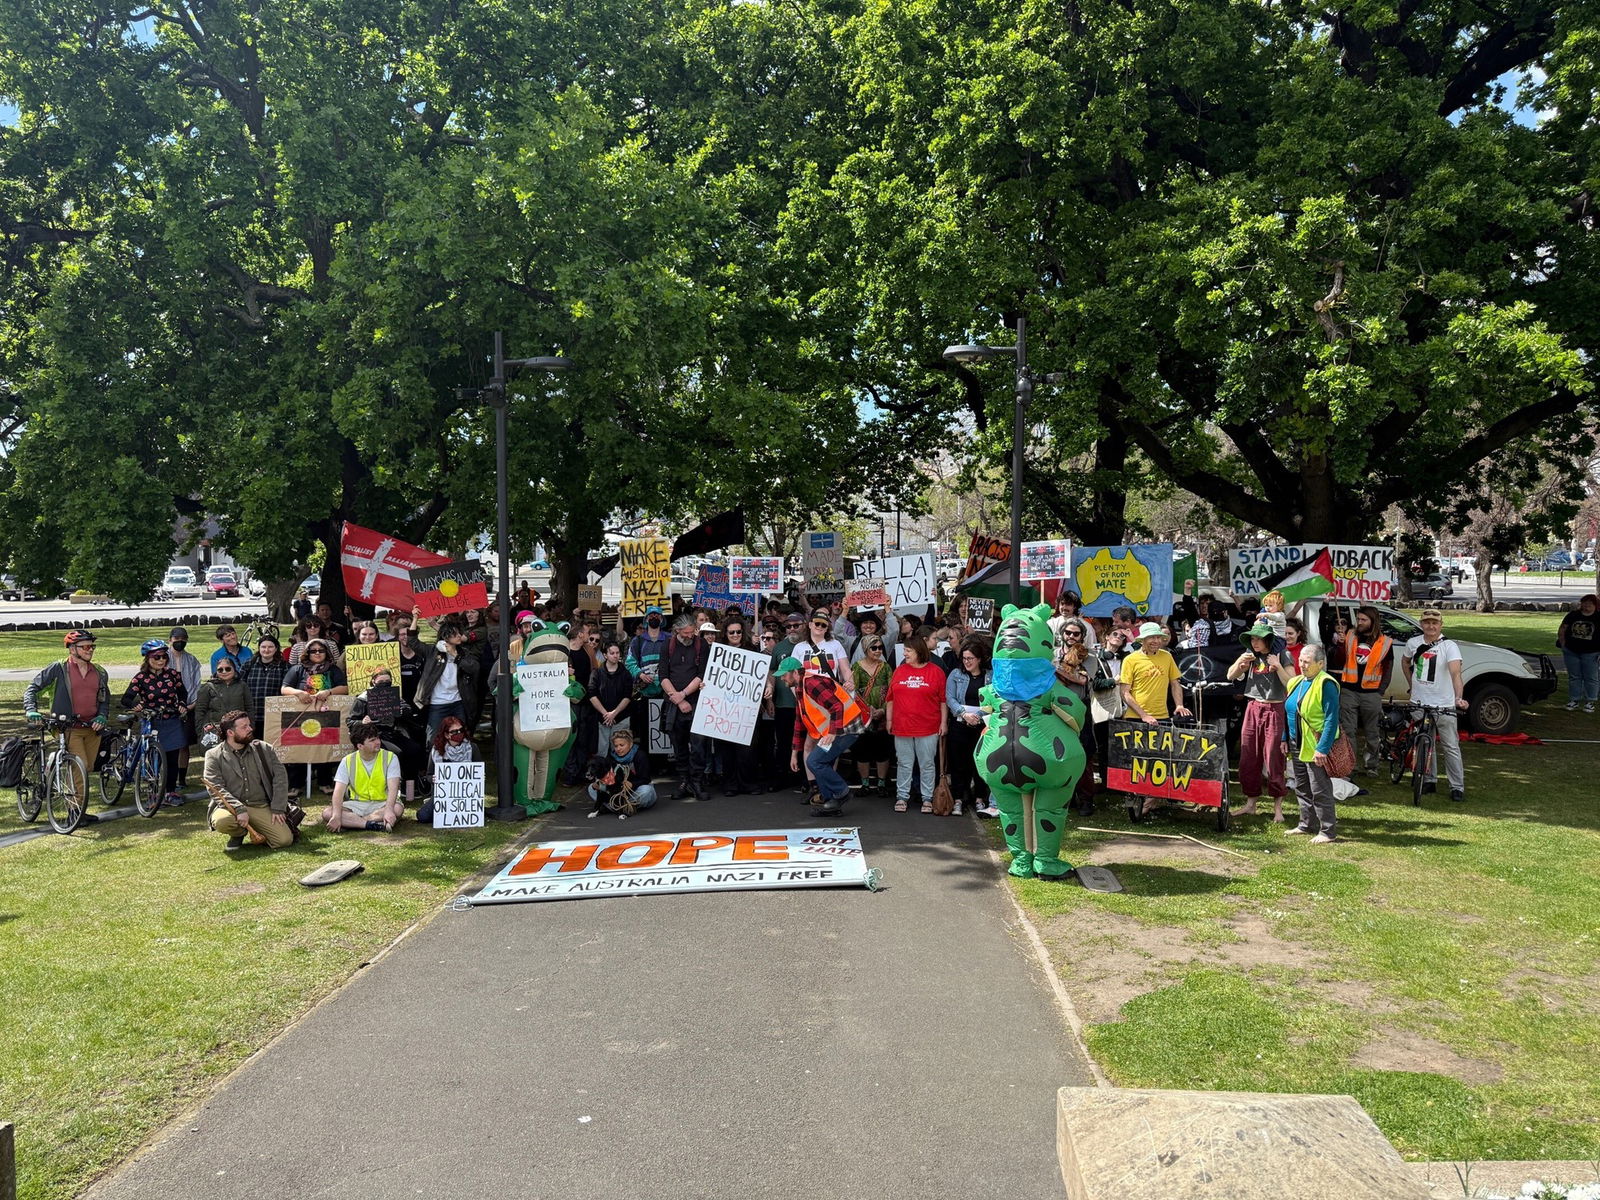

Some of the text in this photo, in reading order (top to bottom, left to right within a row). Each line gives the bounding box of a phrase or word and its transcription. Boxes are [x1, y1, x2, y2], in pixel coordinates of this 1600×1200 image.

[345, 543, 375, 556] SOCIALIST
[620, 540, 668, 566] MAKE
[806, 549, 842, 562] MADE
[1238, 547, 1300, 564] STAND
[620, 563, 669, 580] Australia
[855, 556, 927, 580] BELLA
[1094, 563, 1127, 571] PLENTY
[1232, 561, 1297, 580] AGAIN
[1333, 568, 1368, 580] NOT
[624, 579, 665, 599] NAZI
[1095, 579, 1126, 589] MATE
[429, 594, 472, 611] WILL BE
[579, 590, 597, 599] HOPE
[624, 596, 672, 616] FREE
[968, 617, 992, 629] NOW
[346, 642, 397, 662] SOLIDARITY
[713, 646, 768, 680] PUBLIC
[521, 669, 566, 680] AUSTRALIA
[708, 666, 762, 703] HOUSING
[531, 690, 555, 699] HOME
[702, 696, 757, 719] PRIVATE
[535, 715, 551, 723] ALL
[704, 714, 753, 740] PROFIT
[1114, 729, 1218, 761] TREATY
[438, 765, 482, 780] NO ONE
[1131, 757, 1193, 792] NOW
[434, 781, 484, 799] IS ILLEGAL
[434, 799, 484, 813] ON STOLEN
[443, 813, 479, 826] LAND
[803, 836, 853, 846] NOT
[508, 835, 790, 877] HOPE
[803, 846, 863, 857] HATE
[491, 870, 833, 897] MAKE AUSTRALIA NAZI FREE
